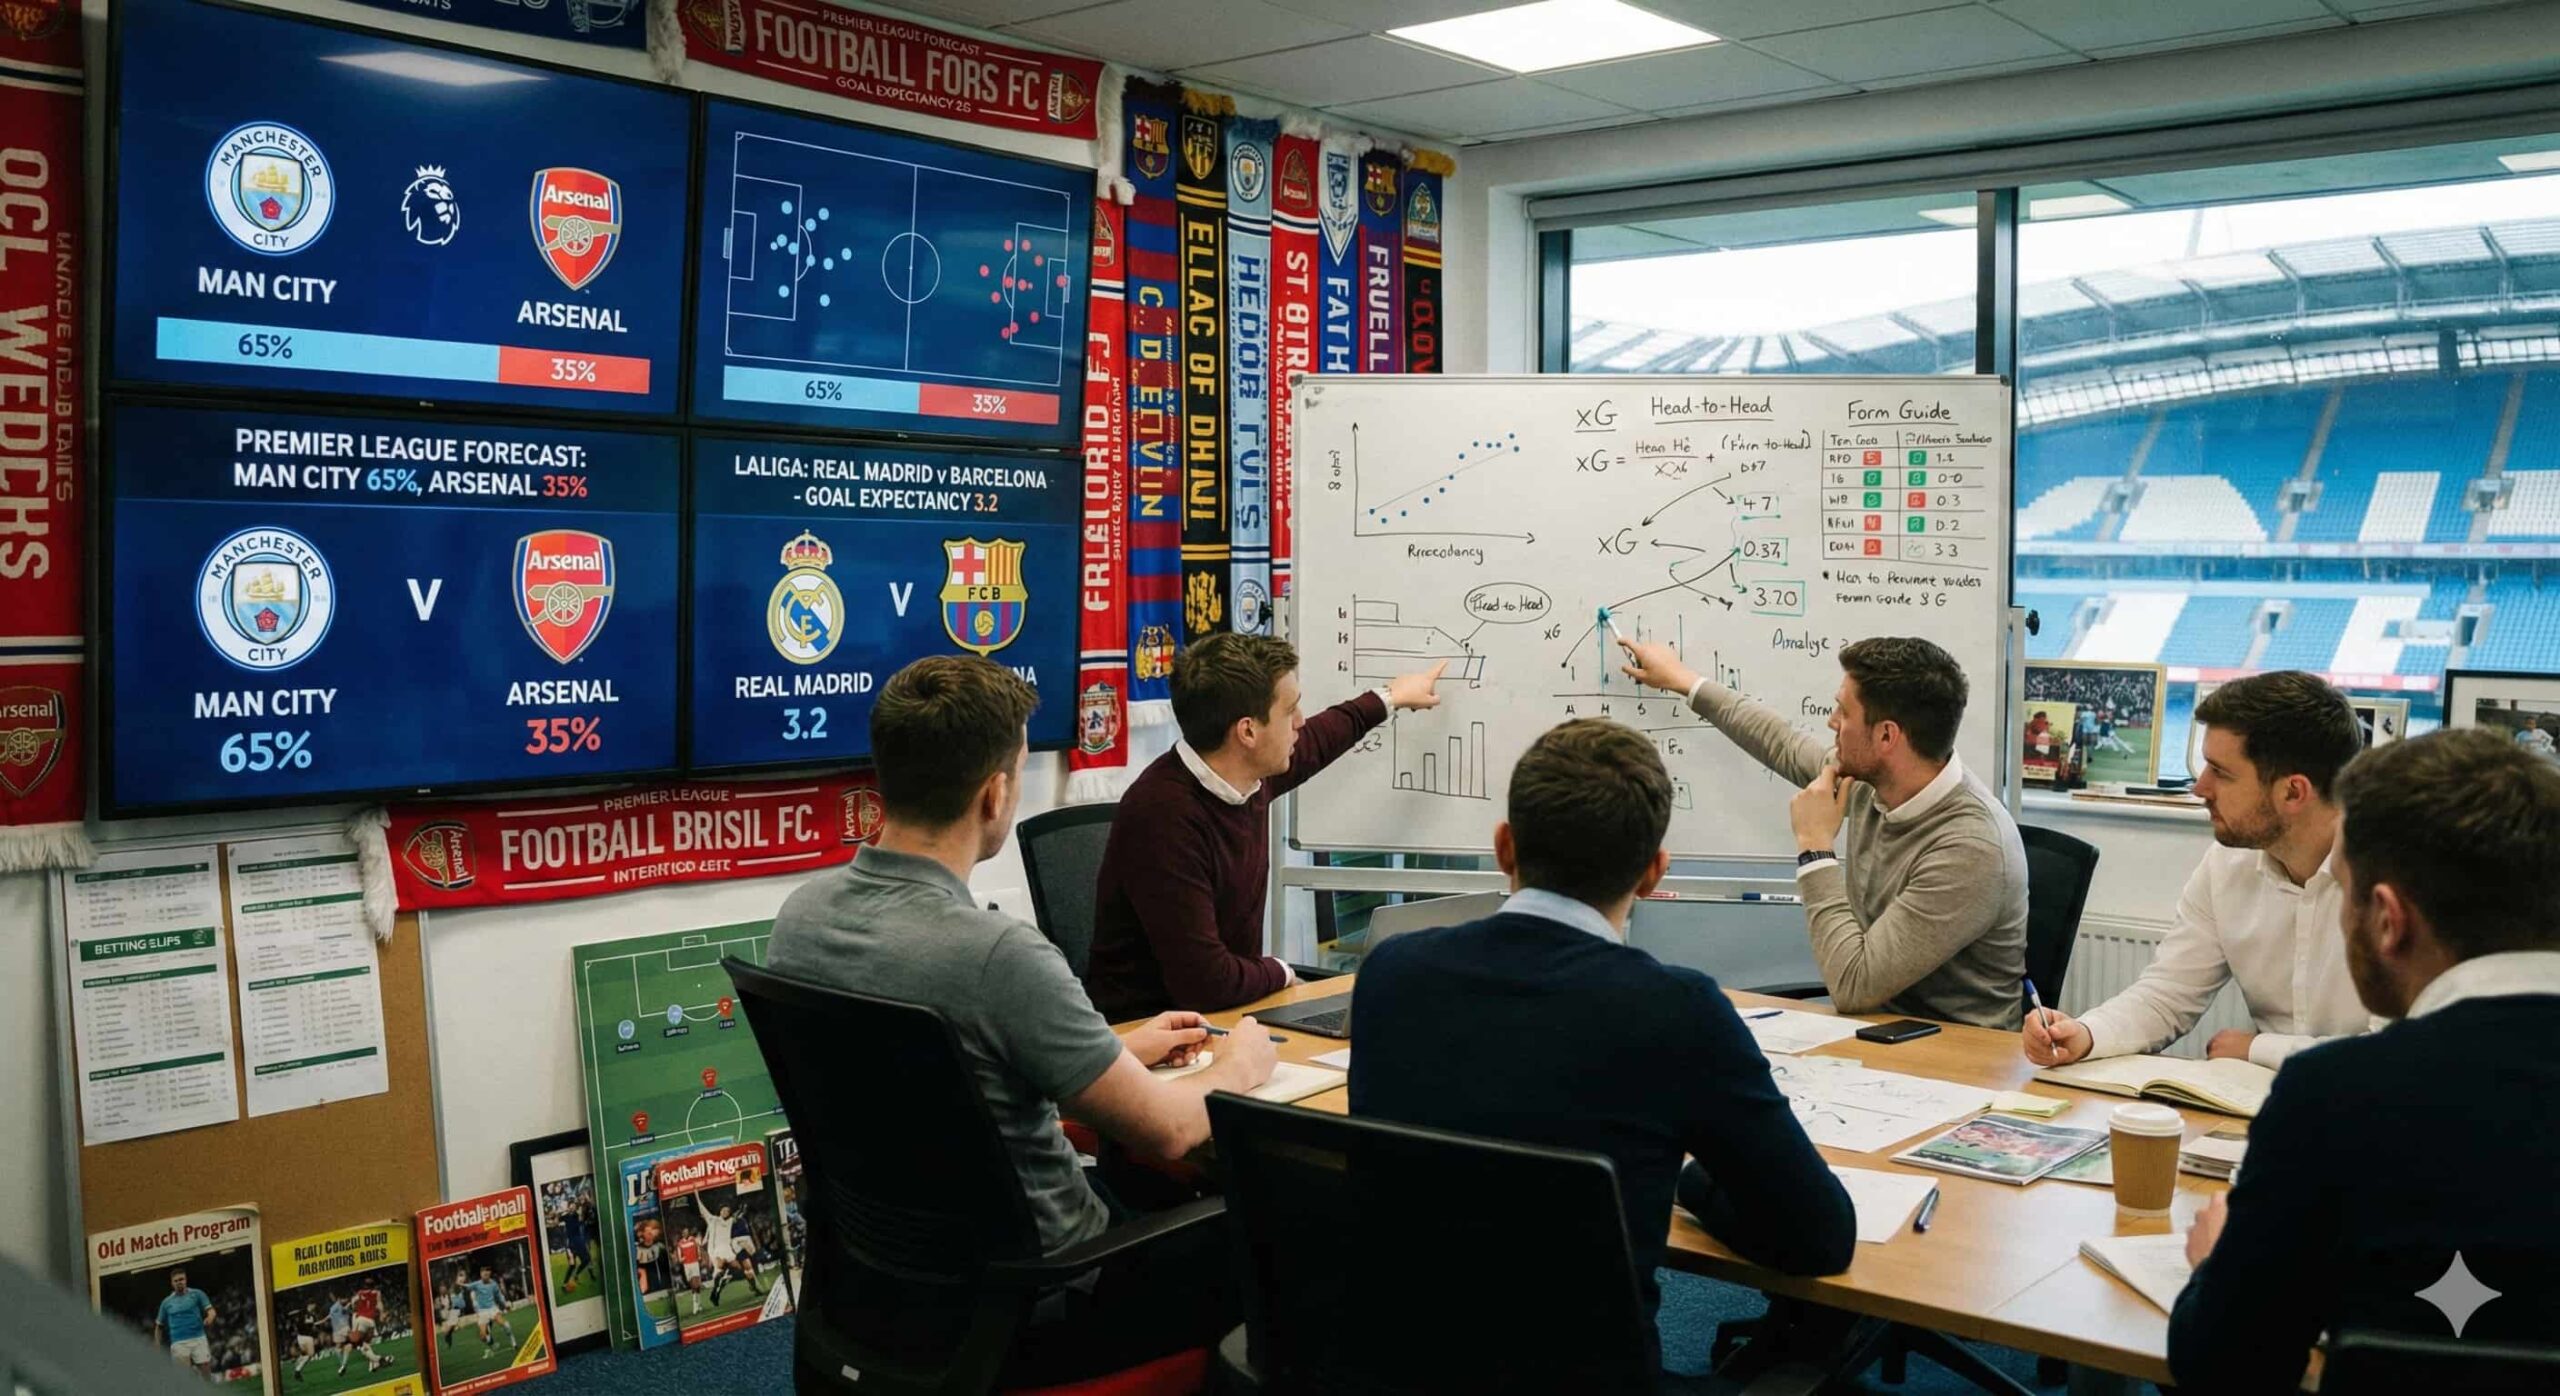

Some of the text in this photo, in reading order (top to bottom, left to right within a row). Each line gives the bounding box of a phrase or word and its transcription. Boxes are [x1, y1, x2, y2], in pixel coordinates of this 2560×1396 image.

[822, 9, 981, 57] PREMIER LEAGUE FORECAST
[754, 9, 915, 87] FOOTBALL
[926, 50, 999, 104] FORS
[1007, 68, 1040, 110] FC
[835, 76, 873, 95] GOAL
[876, 84, 953, 110] EXPECTANCY
[220, 130, 323, 179] MANCHESTER
[544, 184, 610, 212] Arsenal
[252, 232, 289, 248] CITY
[198, 266, 337, 304] MAN CITY
[1188, 220, 1216, 338] ELLAC
[1286, 250, 1310, 297] ST.
[517, 300, 628, 334] ARSENAL
[1367, 244, 1390, 372] FRUELL
[238, 333, 294, 361] 65%
[550, 358, 596, 384] 35%
[805, 381, 843, 401] 65%
[1651, 395, 1774, 417] Head-to-Head
[1576, 399, 1618, 427] xG
[1848, 399, 1952, 420] Form Guide
[235, 428, 587, 469] PREMIER LEAGUE FORECAST:
[1576, 448, 1610, 473] xG
[234, 462, 588, 499] MAN CITY 65%, ARSENAL 35%
[734, 454, 809, 480] LALIGA:
[812, 459, 862, 482] REAL
[864, 462, 934, 485] MADRID
[949, 467, 1048, 489] BARCELONA
[805, 486, 856, 508] GOAL
[859, 489, 972, 512] EXPECTANCY
[973, 492, 999, 513] 3.2
[210, 535, 323, 580] MANCHESTER
[1598, 527, 1638, 556] xG
[528, 550, 601, 572] Arsenal
[407, 578, 443, 622] V
[888, 582, 914, 618] V
[1519, 595, 1544, 612] Head
[248, 648, 288, 662] CITY
[506, 679, 620, 707] ARSENAL
[735, 672, 873, 699] REAL MADRID
[194, 688, 338, 719] MAN CITY
[525, 716, 602, 756] 35%
[782, 707, 828, 741] 3.2
[220, 730, 313, 774] 65%
[603, 788, 730, 812] PREMIER LEAGUE
[501, 803, 821, 872] FOOTBALL BRISIL FC.
[94, 938, 147, 956] BETTING
[97, 1237, 126, 1260] Old
[130, 1227, 179, 1254] Match
[183, 1215, 251, 1241] Program
